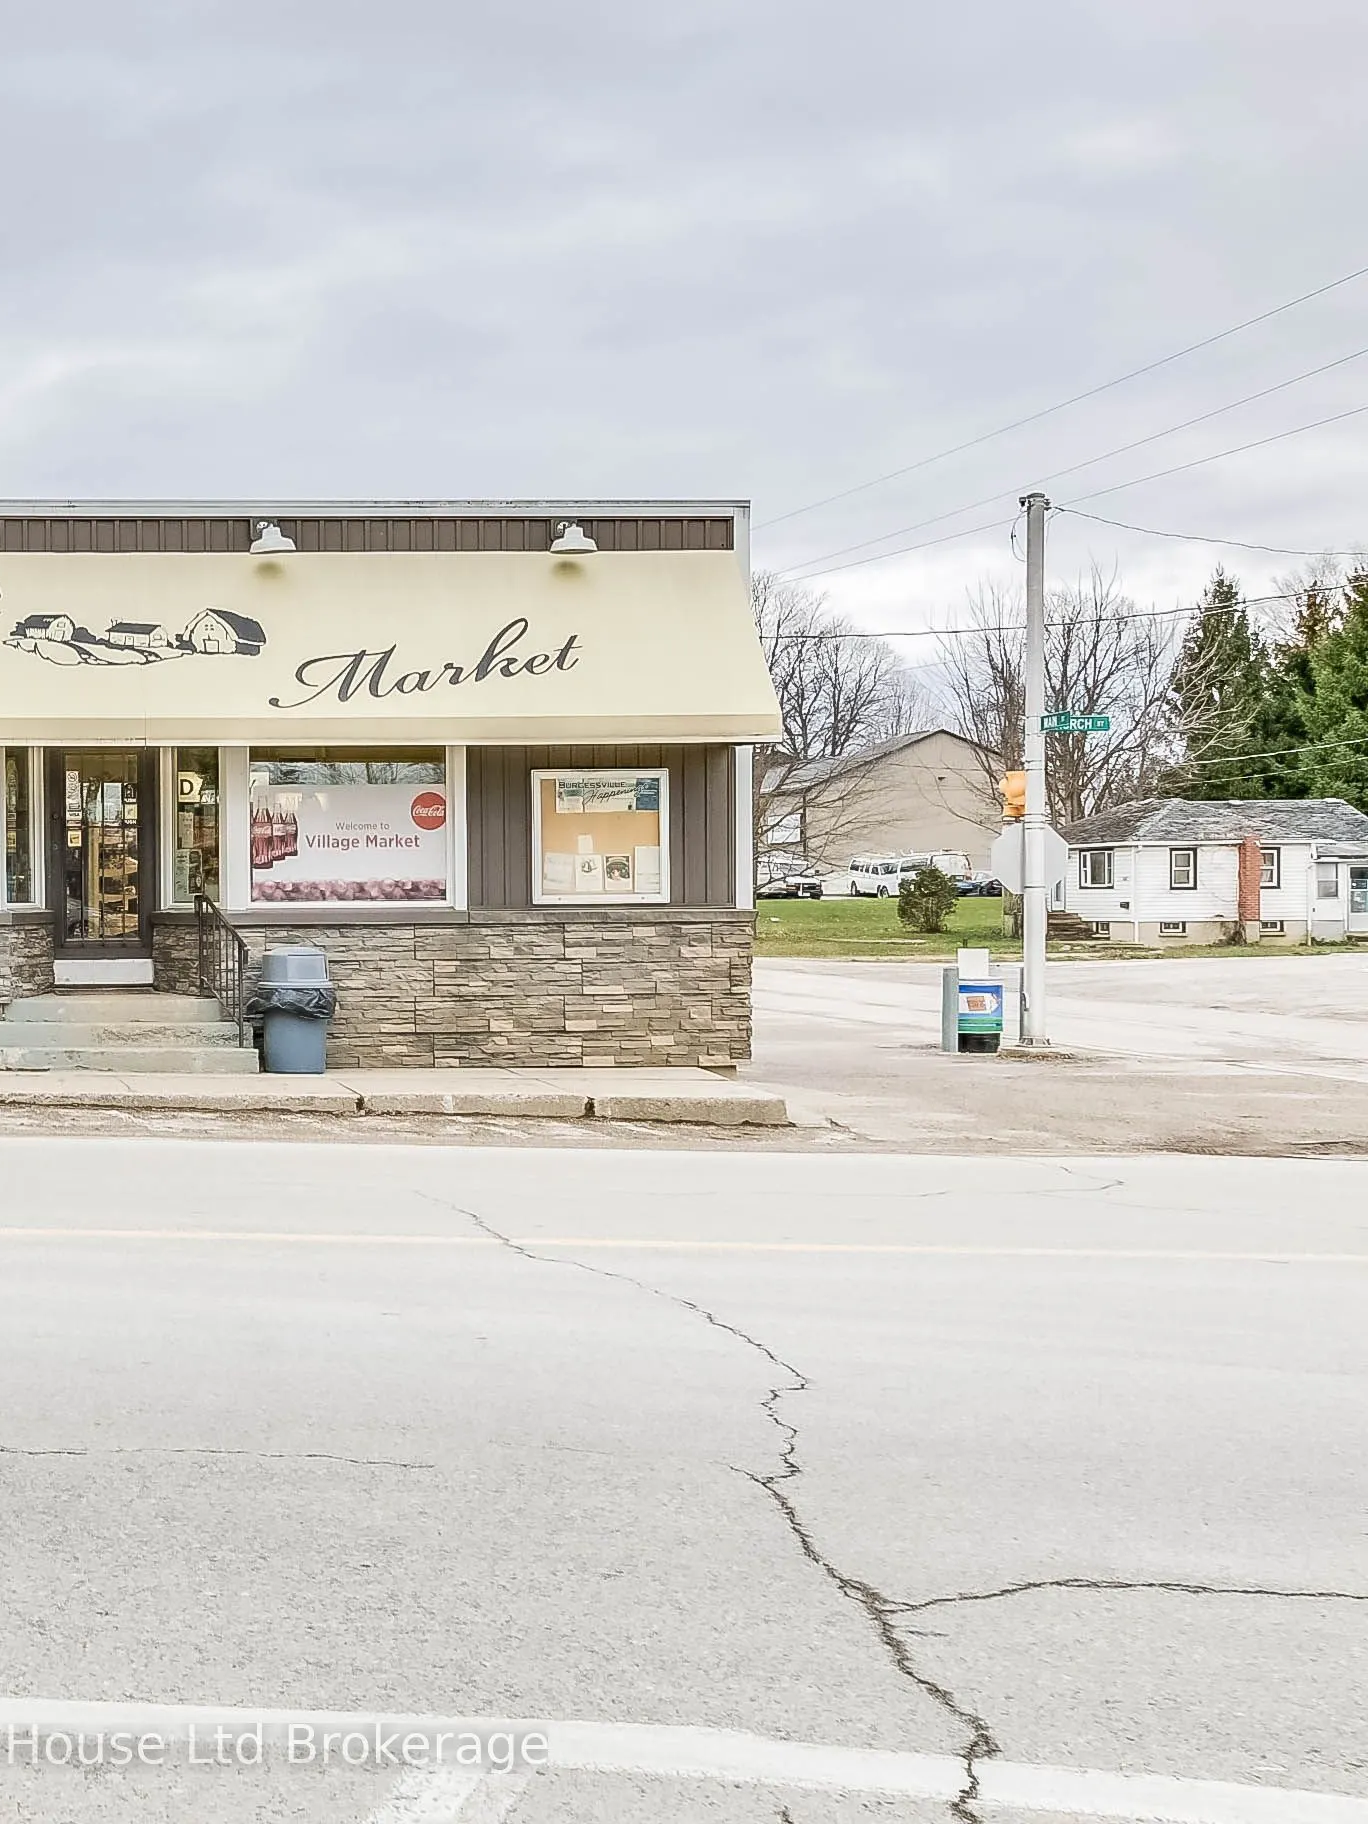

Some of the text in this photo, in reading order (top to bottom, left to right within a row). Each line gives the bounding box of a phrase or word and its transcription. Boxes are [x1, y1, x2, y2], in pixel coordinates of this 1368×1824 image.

[269, 618, 582, 708] Market
[412, 804, 445, 817] Coca-Cola
[335, 822, 390, 831] Welcome to
[305, 834, 420, 850] Village Market
